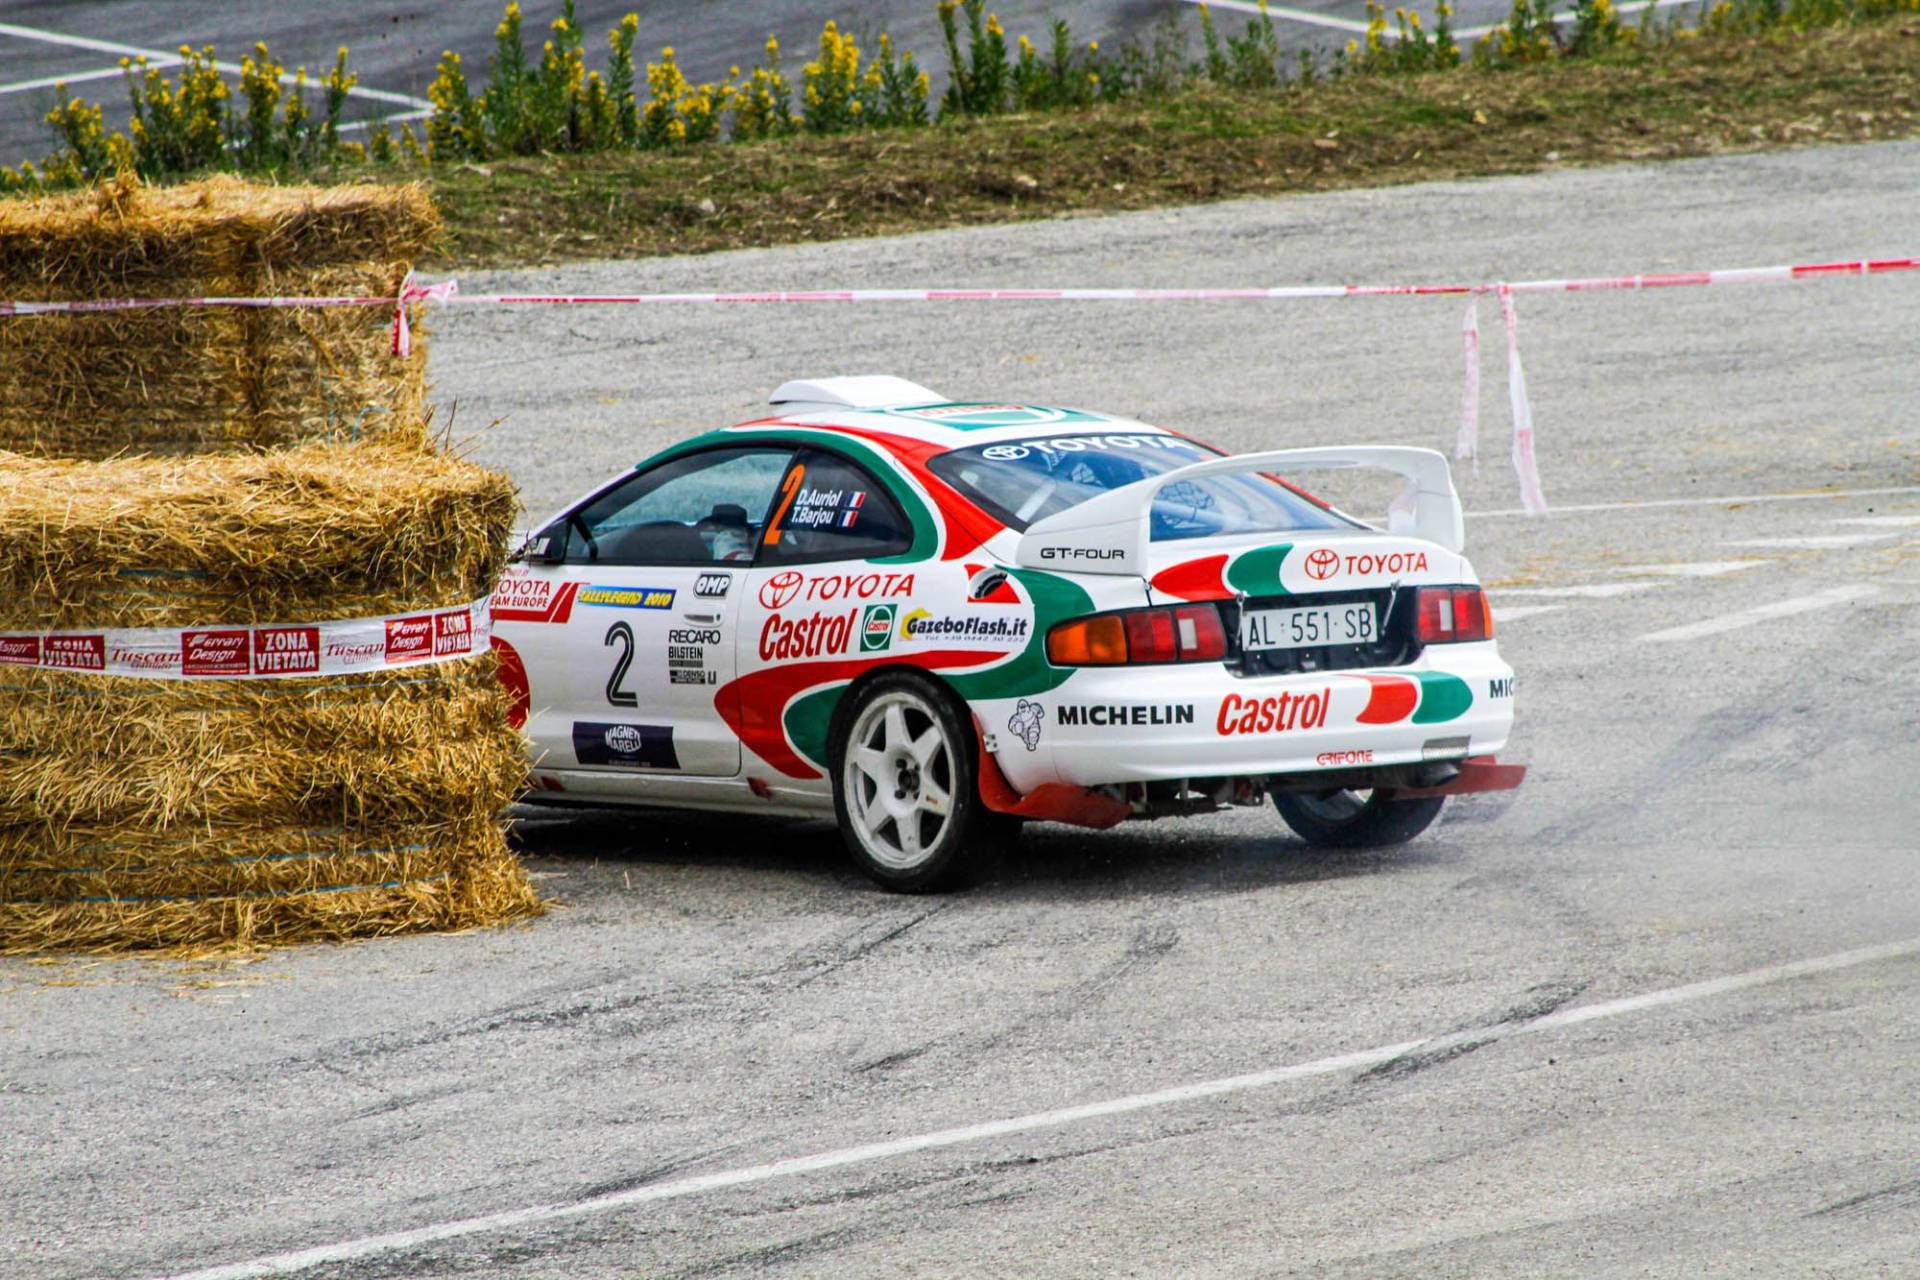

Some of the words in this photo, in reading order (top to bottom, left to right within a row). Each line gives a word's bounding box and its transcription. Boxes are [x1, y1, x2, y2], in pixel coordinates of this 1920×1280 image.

[1021, 436, 1194, 452] TOYOTA
[764, 464, 805, 544] 2
[796, 489, 843, 506] D.Auriol
[791, 506, 834, 528] T.Barjou
[1344, 552, 1428, 577] TOYOTA
[499, 579, 551, 596] OYOTA
[695, 576, 730, 594] OMP
[806, 574, 915, 600] TOYOTA
[511, 596, 548, 608] EUROPE
[758, 607, 858, 662] Castrol
[906, 616, 1028, 636] GazeboFlash.it
[1249, 616, 1276, 646] AL
[1291, 611, 1330, 643] 551
[1344, 608, 1372, 639] SB
[188, 633, 245, 648] Ferrari
[265, 632, 309, 651] ZONA
[668, 629, 721, 645] RECARO
[111, 648, 181, 663] Tuscan
[189, 648, 237, 663] Design
[326, 642, 385, 657] Tuscan
[668, 646, 703, 659] BILSTEIN
[256, 651, 316, 671] VIETATA
[604, 621, 639, 708] 2
[1057, 704, 1195, 726] MICHELIN
[1216, 688, 1331, 736] Castrol
